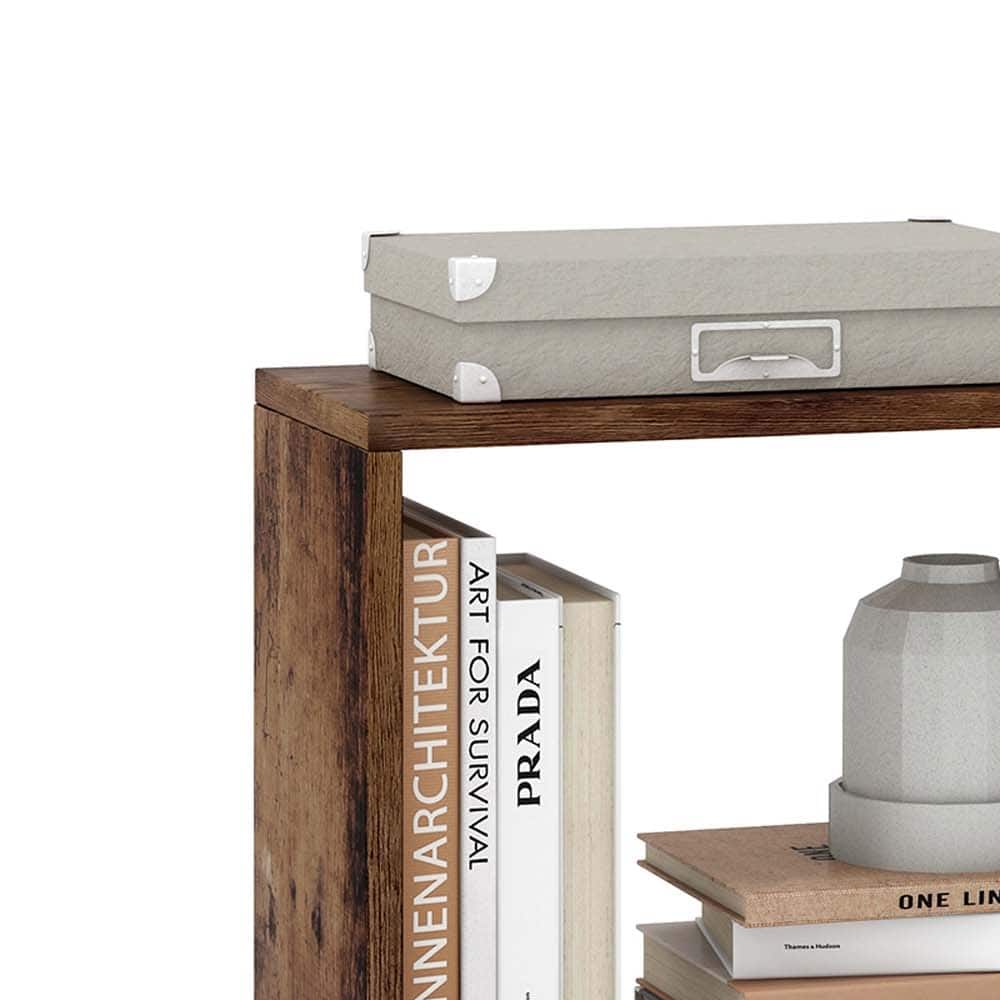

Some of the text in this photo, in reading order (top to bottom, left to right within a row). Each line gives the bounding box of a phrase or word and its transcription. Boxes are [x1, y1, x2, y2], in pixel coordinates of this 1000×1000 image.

[468, 561, 490, 871] ART FOR SURVIVAL
[516, 659, 541, 807] PRADA
[898, 892, 950, 910] ONE
[783, 943, 809, 951] Thames
